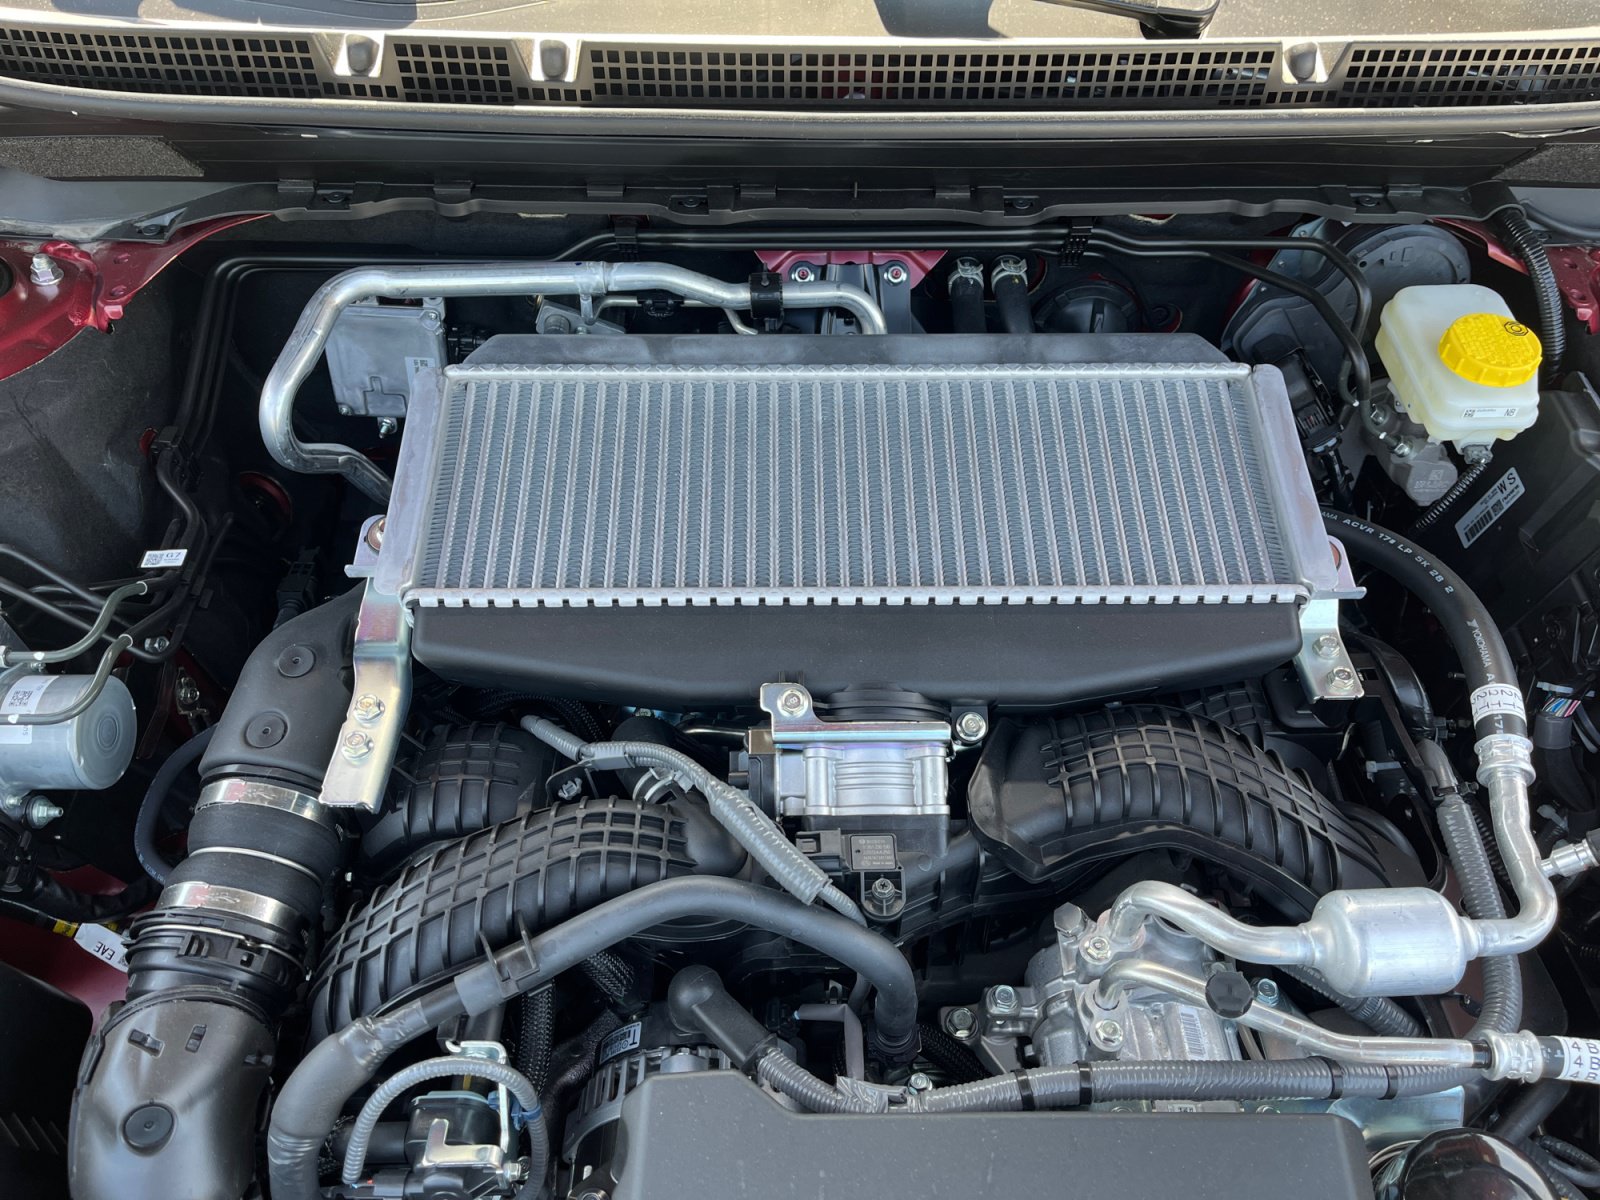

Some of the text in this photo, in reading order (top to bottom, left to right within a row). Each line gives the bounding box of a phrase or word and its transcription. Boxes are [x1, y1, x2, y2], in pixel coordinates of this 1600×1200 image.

[1397, 544, 1413, 554] LP
[1472, 629, 1492, 667] YOKOHAMA
[93, 941, 115, 961] EAE
